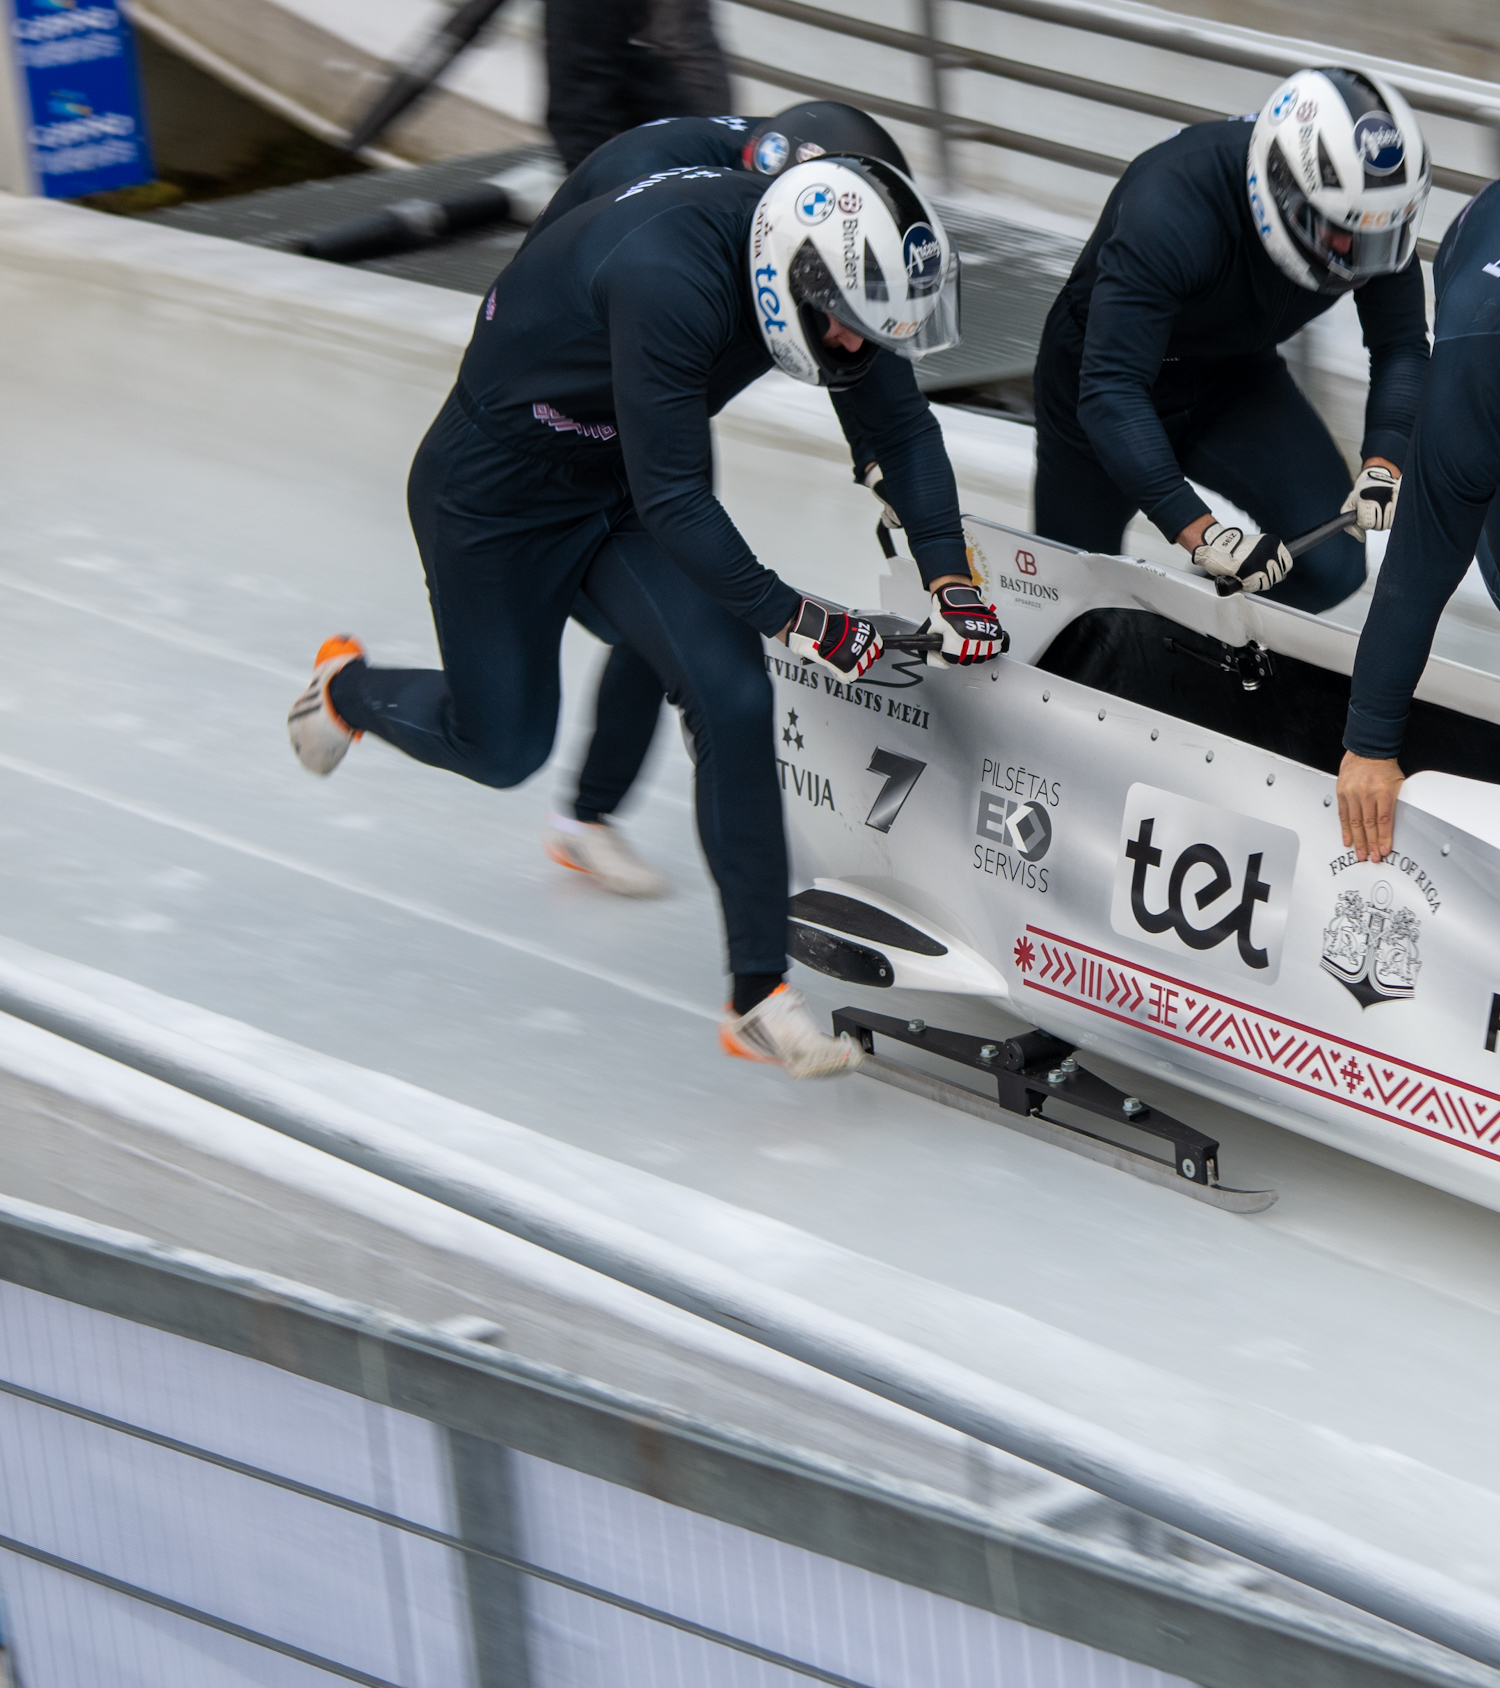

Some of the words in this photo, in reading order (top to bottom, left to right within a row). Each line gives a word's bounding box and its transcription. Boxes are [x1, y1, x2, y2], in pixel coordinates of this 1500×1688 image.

[842, 218, 860, 291] Binders
[755, 263, 788, 334] tet
[1222, 533, 1238, 548] SEIZ
[1000, 574, 1059, 602] BASTIONS
[851, 621, 871, 656] SEIZ
[964, 618, 999, 638] SEIZ
[763, 654, 819, 690] TVIJAS
[823, 675, 883, 713] VALSTS
[887, 698, 930, 730] MEŽI
[776, 757, 836, 811] TVIJA
[865, 745, 928, 834] 7
[980, 758, 1062, 808] PILSĒTAS
[973, 844, 1050, 894] SERVISS
[1125, 817, 1272, 970] tet
[1399, 856, 1419, 876] OF
[1414, 869, 1442, 916] RIGA
